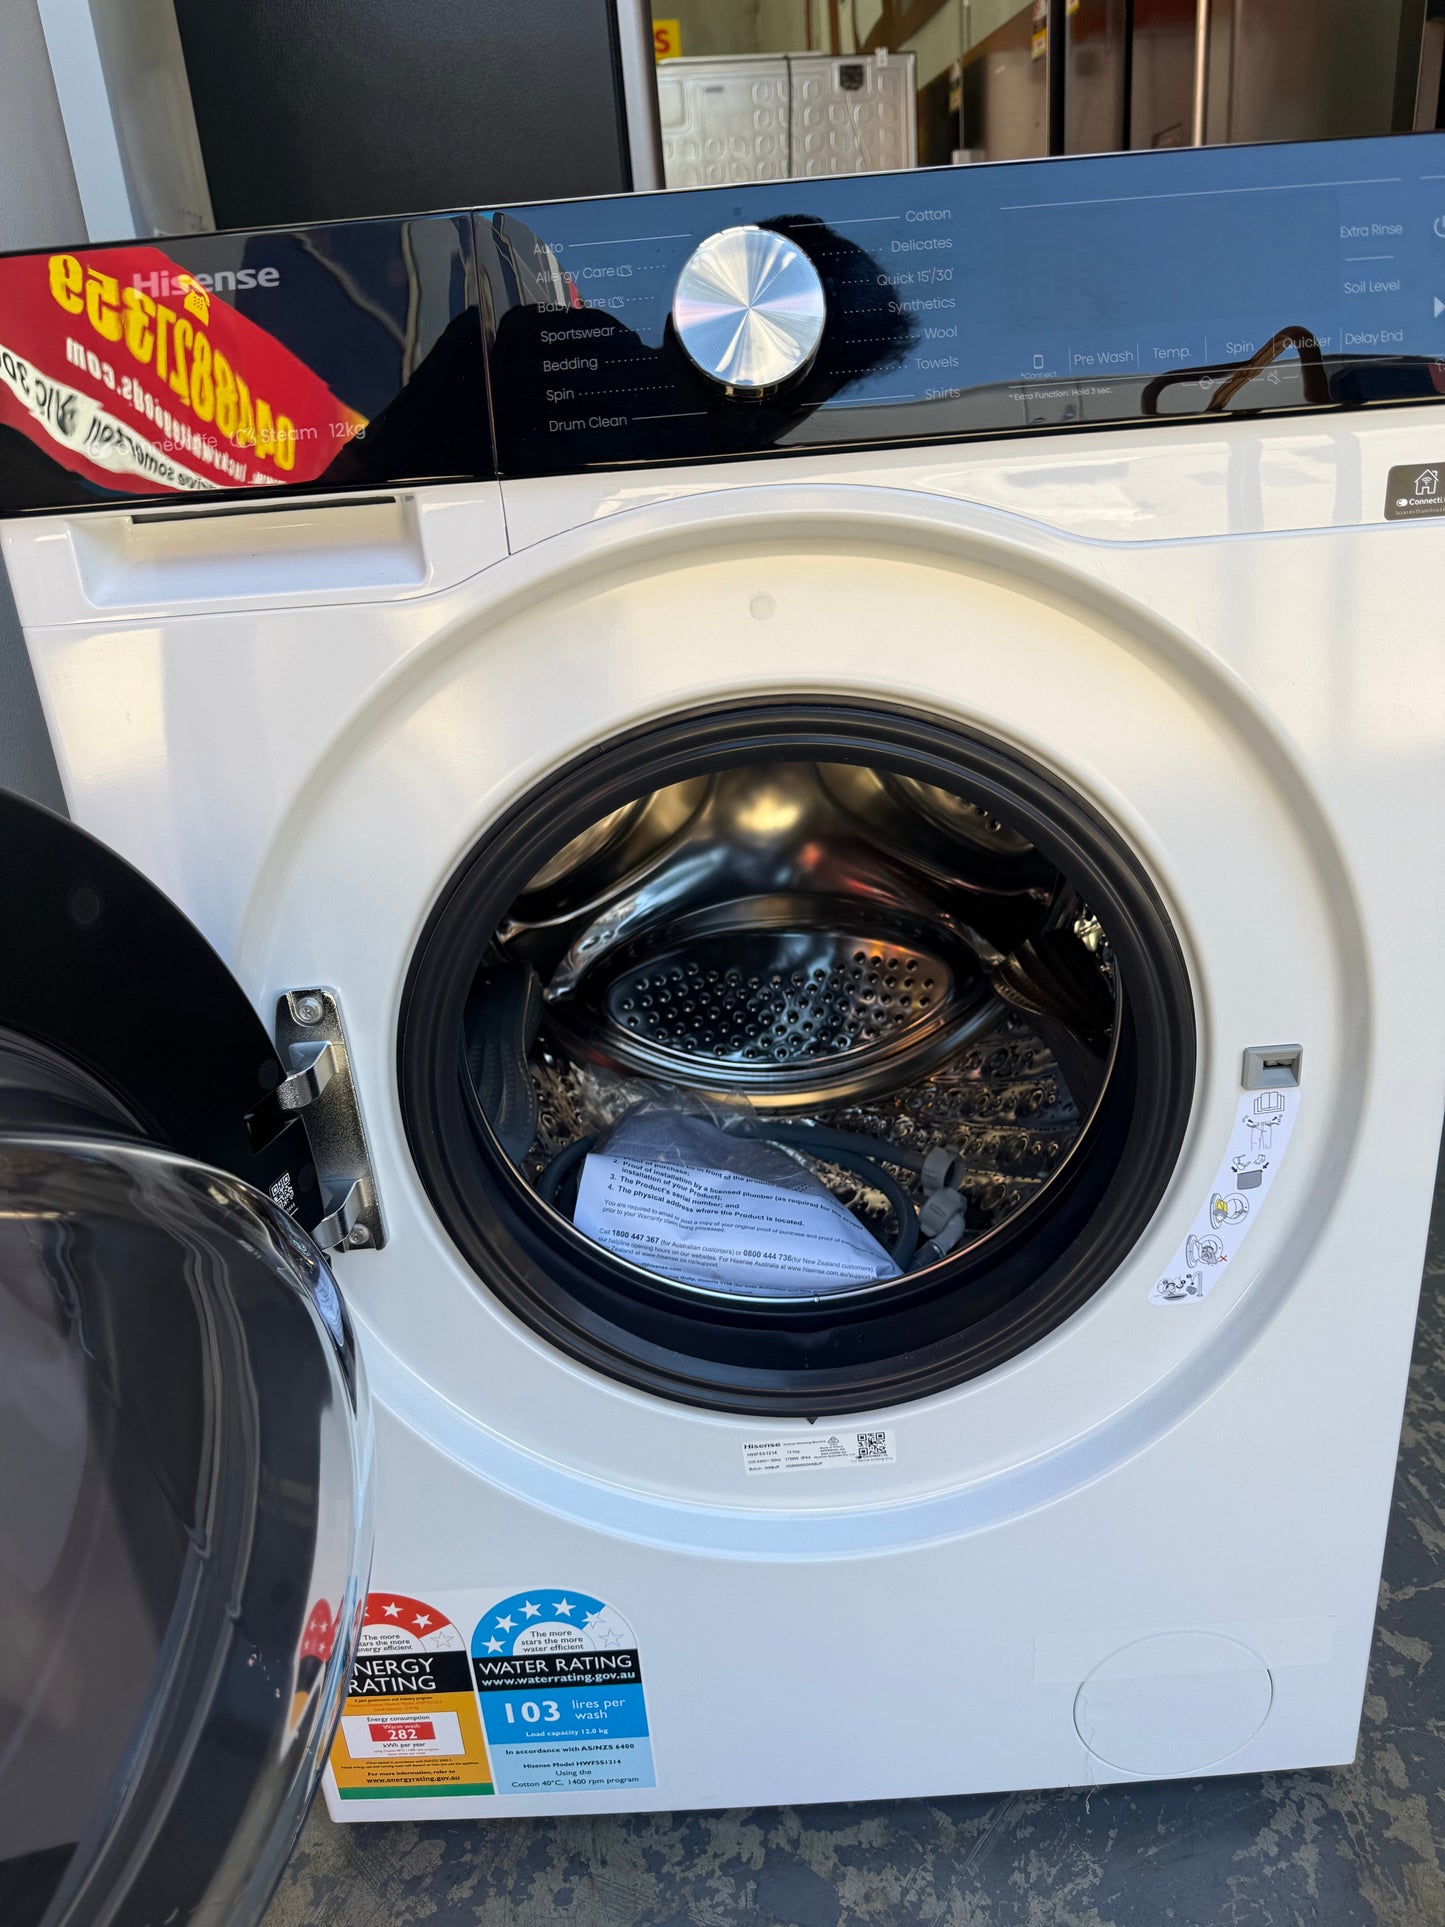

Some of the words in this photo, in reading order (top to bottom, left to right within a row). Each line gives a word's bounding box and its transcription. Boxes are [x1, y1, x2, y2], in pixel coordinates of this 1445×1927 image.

[905, 209, 951, 222] Cotton
[1340, 225, 1369, 238] Extra
[1371, 223, 1403, 236] Rinse
[533, 242, 563, 255] Auto
[891, 238, 953, 253] Delicates
[133, 267, 280, 298] Hisense
[536, 269, 579, 284] Allergy
[583, 266, 615, 279] Care
[877, 272, 914, 286] Quick
[1344, 280, 1366, 294] Soil
[1369, 279, 1400, 293] Level
[538, 300, 570, 314] Baby
[574, 297, 606, 309] Care
[888, 297, 956, 315] Synthetics
[540, 327, 615, 344] Sportswear
[924, 325, 958, 339] Wool
[1345, 331, 1378, 347] Delay
[1381, 330, 1402, 343] End
[1226, 340, 1254, 356] Spin
[1282, 335, 1332, 350] Quicker
[1074, 354, 1094, 366] Pre
[1097, 350, 1134, 364] Wash
[1152, 346, 1192, 361] Temp.
[543, 357, 598, 372] Bedding
[915, 356, 959, 369] Towels
[546, 388, 574, 403] Spin
[925, 387, 960, 400] Shirts
[549, 420, 586, 432] Drum
[589, 416, 627, 429] Clean
[261, 427, 318, 443] Steam
[328, 422, 366, 439] 12kg
[620, 1175, 633, 1184] The
[618, 1185, 631, 1194] The
[633, 1190, 664, 1203] physical
[666, 1199, 694, 1213] address
[734, 1211, 764, 1220] Product
[612, 1229, 629, 1238] 1800
[645, 1236, 660, 1244] 367
[743, 1249, 761, 1258] 0800
[744, 1442, 781, 1450] Hisense
[530, 1630, 548, 1638] The
[544, 1637, 558, 1645] the
[354, 1657, 434, 1676] NERGY
[479, 1660, 549, 1676] WATER
[555, 1655, 632, 1672] RATING
[349, 1675, 437, 1693] RATING
[482, 1671, 635, 1687] www.waterrating.gov.au
[505, 1700, 560, 1724] 103
[572, 1699, 599, 1709] lires
[604, 1698, 626, 1711] per
[575, 1710, 608, 1720] wash
[387, 1729, 418, 1740] 282
[547, 1729, 579, 1737] capacity
[515, 1747, 560, 1755] accordance
[581, 1744, 614, 1752] AS/NZS
[511, 1780, 540, 1788] Cotton
[606, 1776, 640, 1784] program
